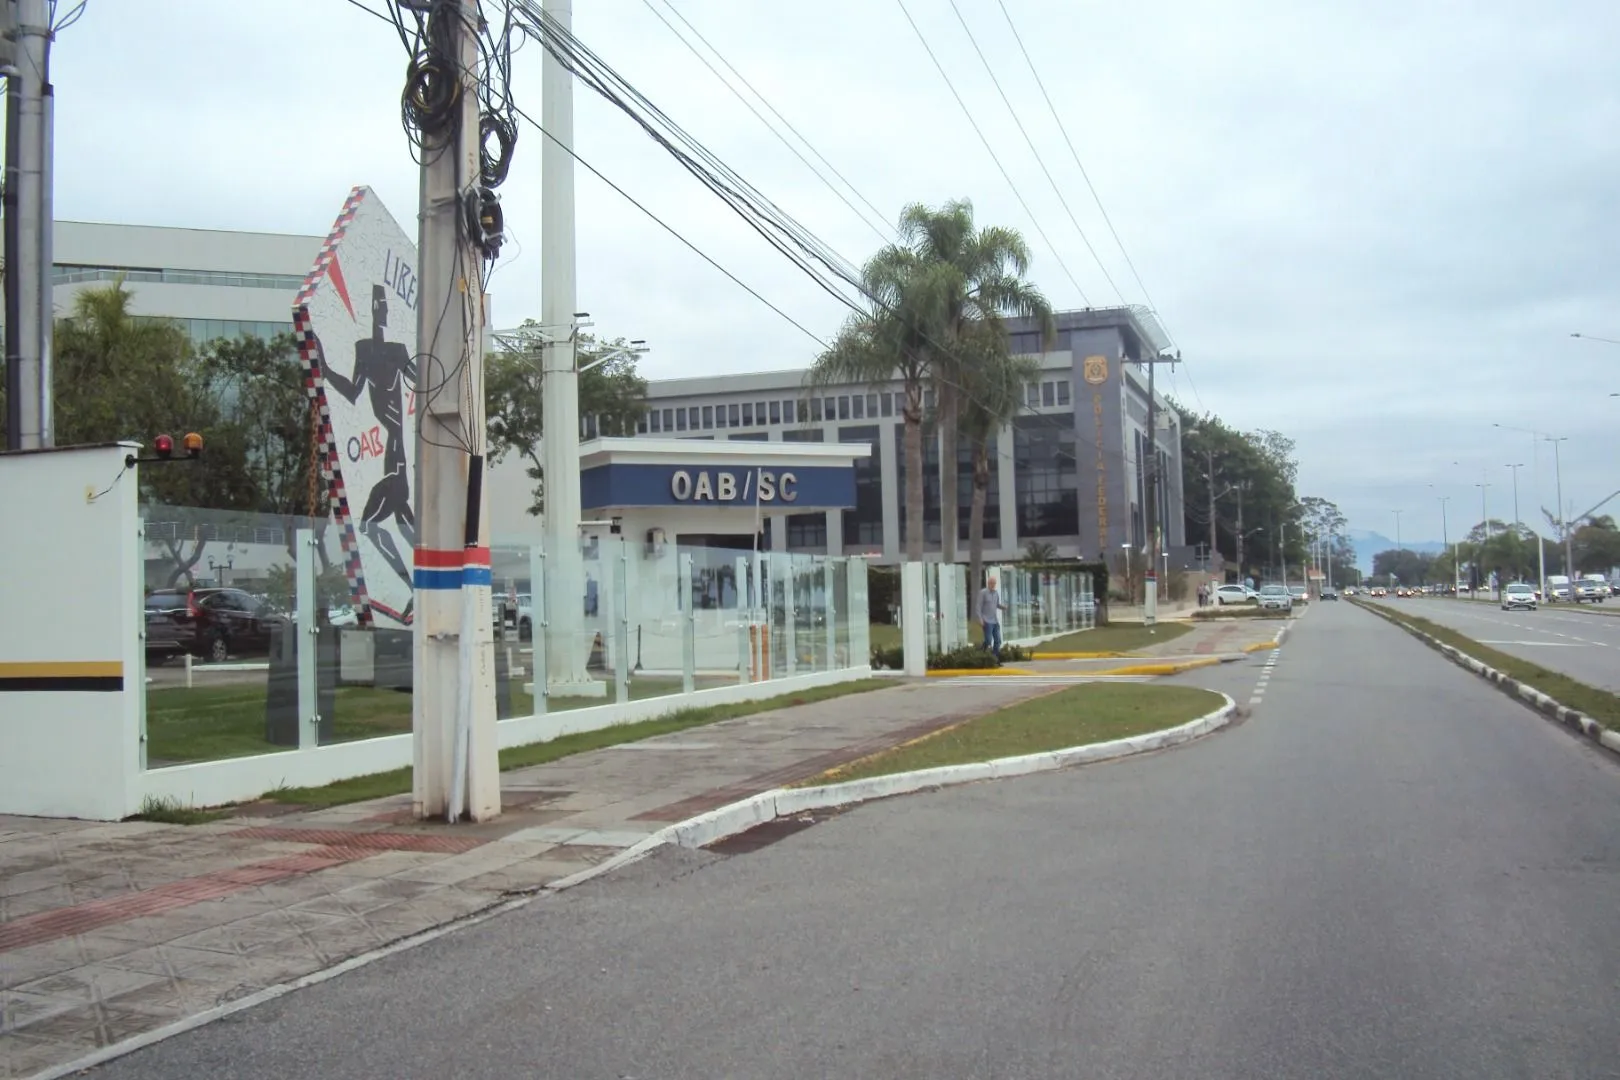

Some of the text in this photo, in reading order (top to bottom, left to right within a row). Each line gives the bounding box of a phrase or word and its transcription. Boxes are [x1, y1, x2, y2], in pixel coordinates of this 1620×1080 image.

[384, 248, 418, 310] LIBE
[347, 425, 384, 462] OAB
[671, 470, 798, 501] OAB/SC
[1097, 474, 1109, 548] FEDERAL
